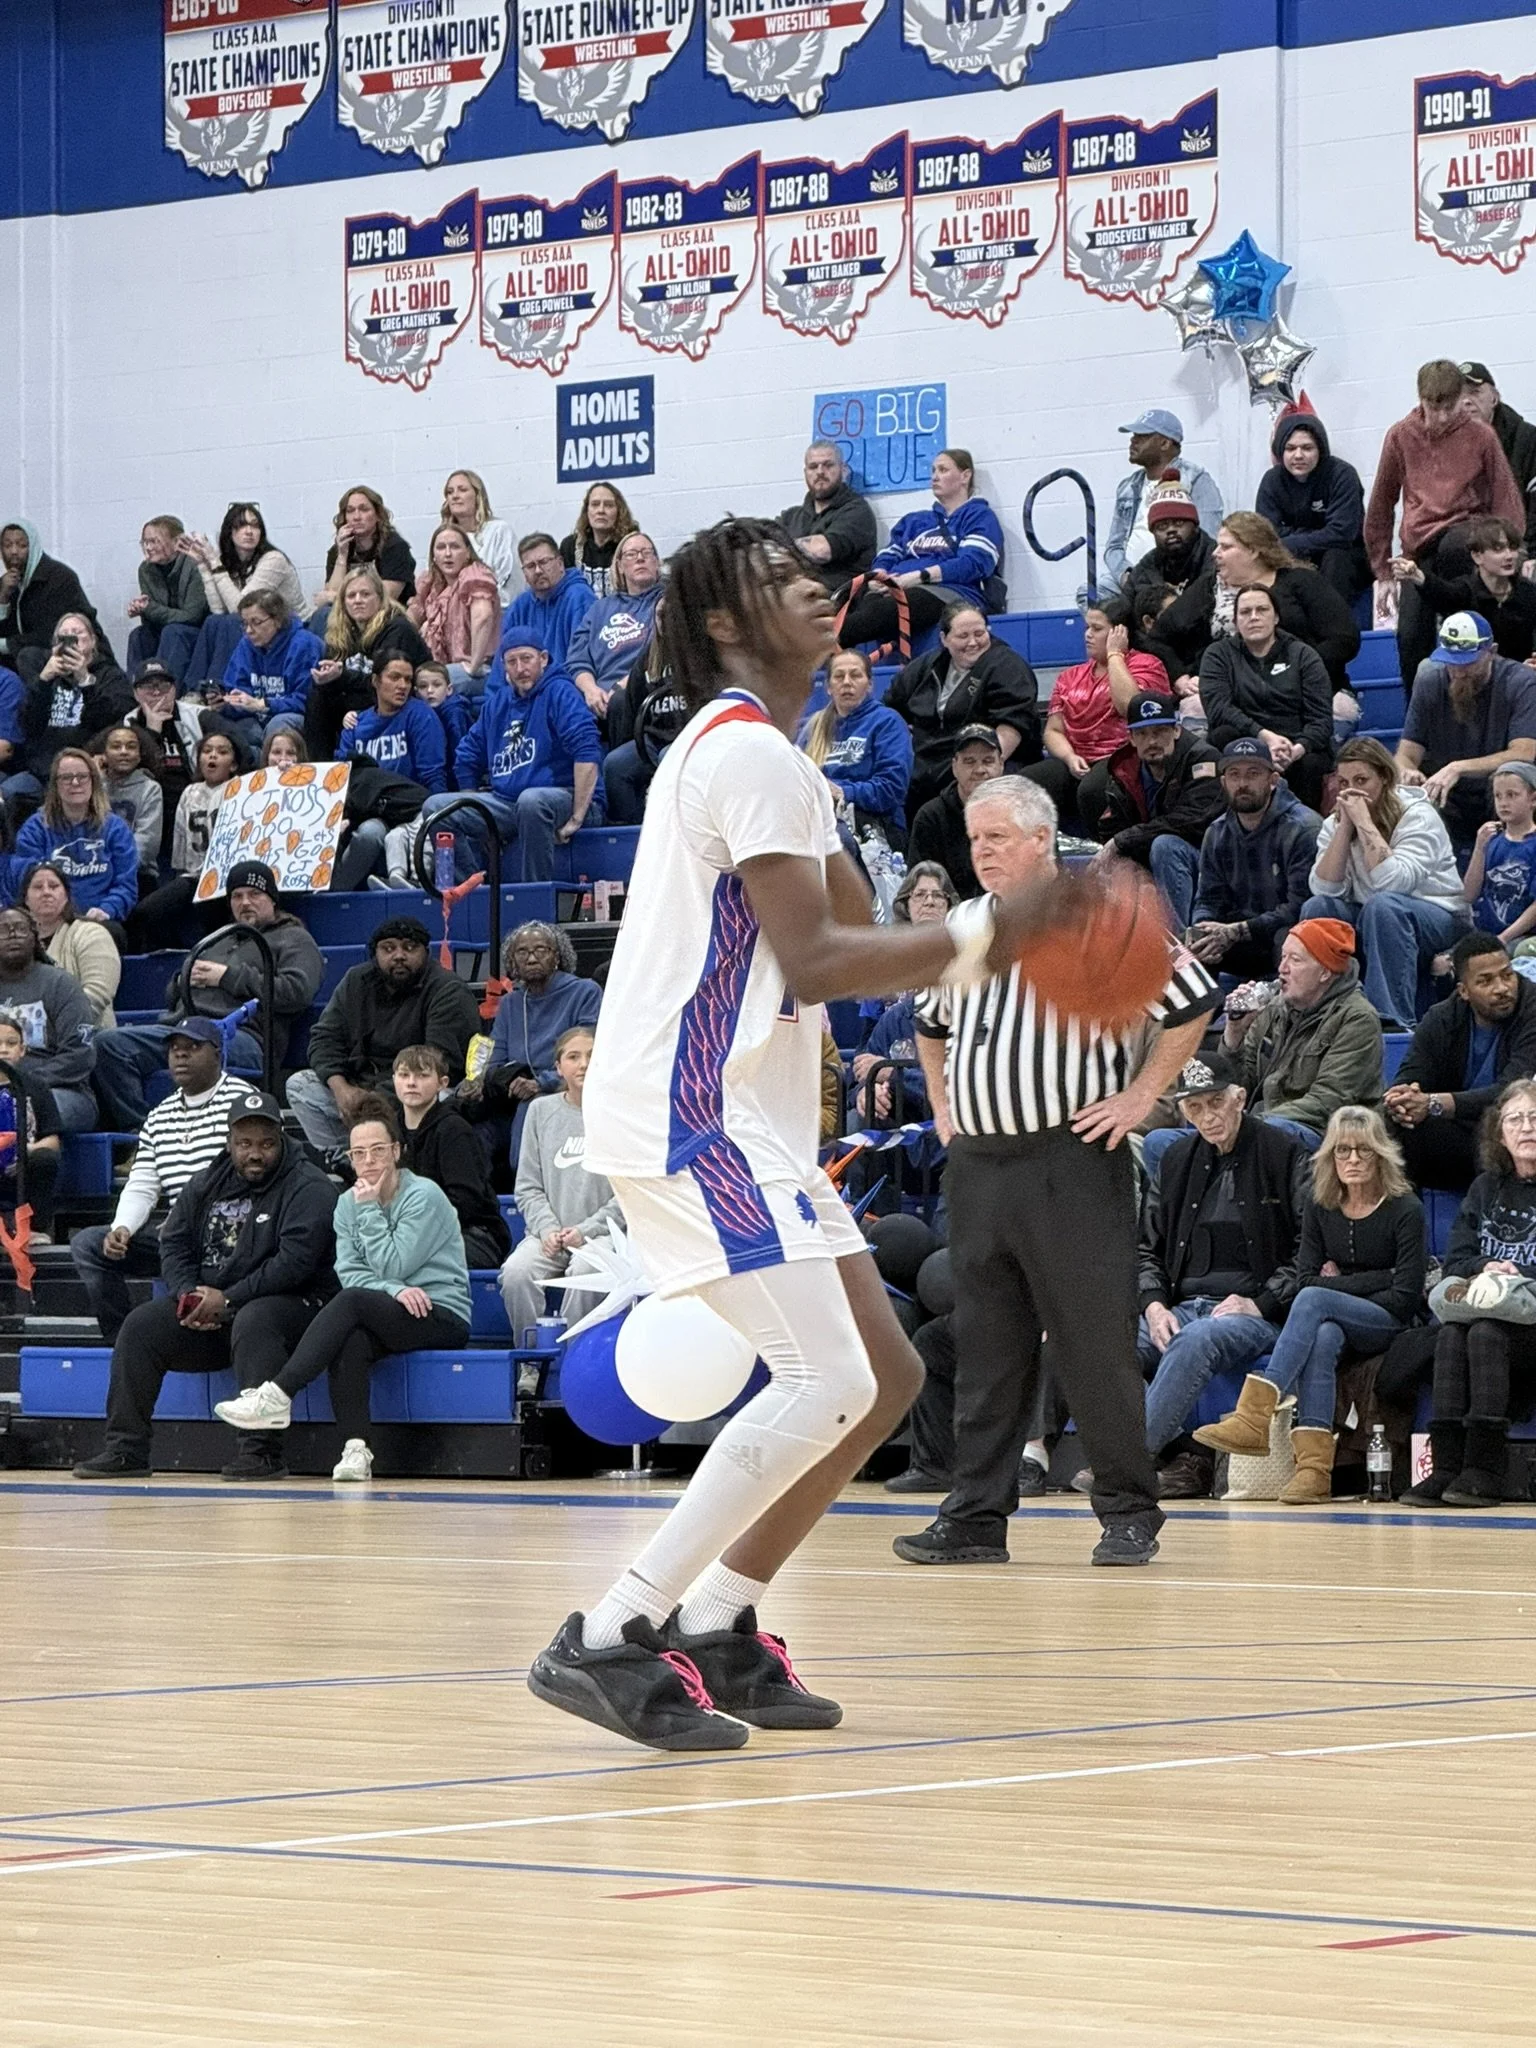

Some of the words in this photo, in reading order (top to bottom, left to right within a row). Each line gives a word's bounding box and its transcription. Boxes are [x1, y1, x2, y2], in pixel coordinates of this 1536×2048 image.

[388, 0, 443, 24] DIVISION
[523, 4, 574, 46] STATE
[580, 0, 688, 38] RUNNER-UP
[765, 9, 830, 34] WRESTLING
[213, 26, 248, 50] CLASS
[252, 23, 277, 44] AAA
[345, 31, 392, 72] STATE
[398, 15, 500, 64] CHAMPIONS
[575, 39, 637, 63] WRESTLING
[171, 56, 217, 97] STATE
[222, 41, 320, 89] CHAMPIONS
[392, 65, 452, 88] WRESTLING
[218, 94, 245, 113] BOYS
[248, 90, 272, 109] GOLF
[1424, 87, 1491, 126] 1990-91
[1072, 131, 1136, 168] 1987-88
[1468, 129, 1521, 150] DIVISION
[918, 152, 979, 188] 1987-88
[1112, 170, 1159, 192] DIVISION
[1163, 169, 1170, 185] II
[770, 172, 829, 208] 1987-88
[956, 190, 1001, 211] DIVISION
[1005, 189, 1013, 205] II
[1467, 188, 1486, 204] TIM
[1487, 183, 1530, 202] CONTANT
[626, 191, 682, 226] 1982-83
[806, 212, 836, 230] CLASS
[839, 209, 860, 225] AAA
[1093, 188, 1189, 228] ALL-OHIO
[1475, 207, 1521, 224] BASEBALL
[487, 210, 543, 244] 1979-80
[661, 230, 690, 248] CLASS
[693, 227, 714, 243] AAA
[938, 208, 1030, 247] ALL-OHIO
[1095, 228, 1147, 246] ROOSEVELT
[1148, 222, 1188, 240] WAGNER
[353, 227, 406, 261] 1979-80
[521, 248, 549, 266] CLASS
[552, 245, 572, 261] AAA
[789, 227, 877, 265] ALL-OHIO
[954, 247, 984, 263] SONNY
[985, 243, 1015, 260] JONES
[385, 266, 413, 282] CLASS
[415, 263, 435, 278] AAA
[645, 245, 730, 282] ALL-OHIO
[807, 266, 829, 281] MATT
[831, 262, 860, 278] BAKER
[505, 263, 588, 299] ALL-OHIO
[665, 283, 682, 298] JIM
[370, 280, 450, 315] ALL-OHIO
[519, 301, 541, 316] GREG
[542, 296, 574, 313] POWELL
[380, 317, 401, 331] GREG
[402, 312, 440, 328] MATHEWS
[570, 388, 640, 426] HOME
[817, 399, 864, 438] GO
[875, 388, 940, 436] BIG
[561, 431, 650, 471] ADULTS
[241, 788, 280, 821] CJ
[281, 783, 326, 827] ROSS
[294, 844, 323, 859] GO
[287, 859, 313, 874] CJ
